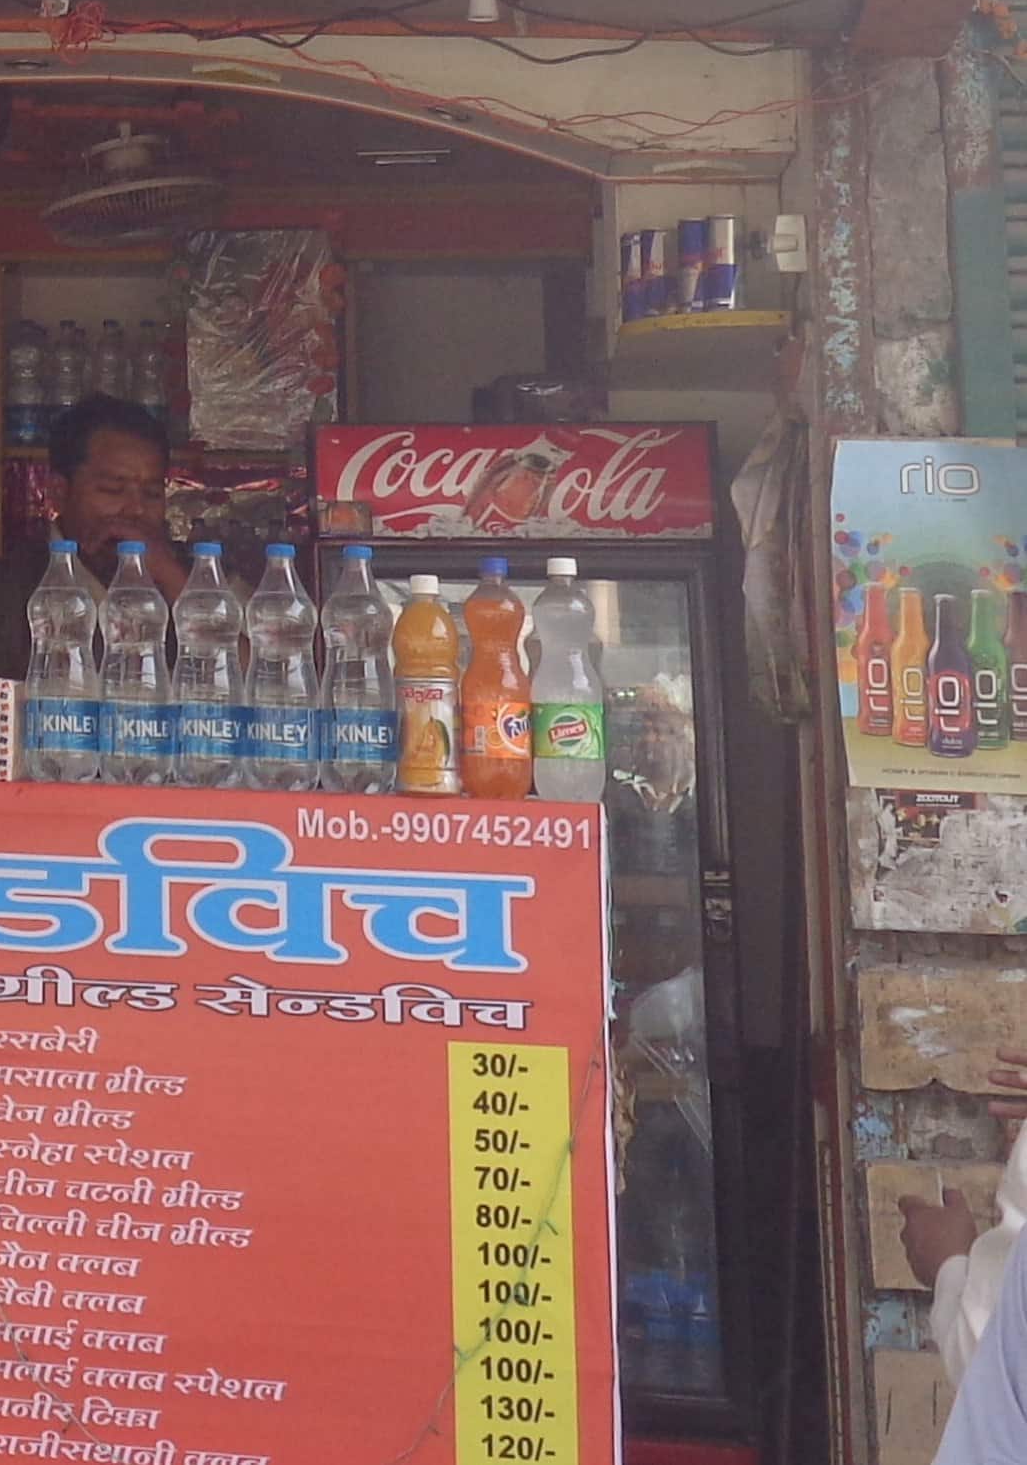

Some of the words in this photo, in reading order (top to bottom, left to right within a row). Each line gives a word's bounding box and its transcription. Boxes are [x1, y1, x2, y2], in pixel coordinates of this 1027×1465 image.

[900, 455, 980, 495] rio
[866, 658, 889, 712] rio
[900, 668, 925, 721] rio
[973, 670, 998, 725] rio
[934, 676, 961, 732] rio
[123, 718, 169, 736] KINLE
[183, 718, 241, 738] KINLEY
[247, 722, 308, 742] KINLEY
[297, 808, 592, 848] Mob.-9907452491
[195, 976, 532, 1030] सेन्डविच
[473, 1053, 528, 1079] 30/-
[473, 1092, 529, 1117] 40/-
[83, 1139, 193, 1170] स्पेशल
[474, 1129, 530, 1154] 50/-
[66, 1176, 155, 1205] चटनी
[474, 1167, 531, 1192] 70/-
[96, 1212, 163, 1241] चीज
[476, 1205, 532, 1230] 80/-
[478, 1243, 552, 1268] 100/-
[478, 1280, 552, 1306] 100/-
[479, 1319, 553, 1345] 100/-
[480, 1357, 554, 1383] 100/-
[174, 1368, 286, 1401] स्पेशल
[481, 1396, 555, 1421] 130/-
[482, 1435, 556, 1461] 120/-
